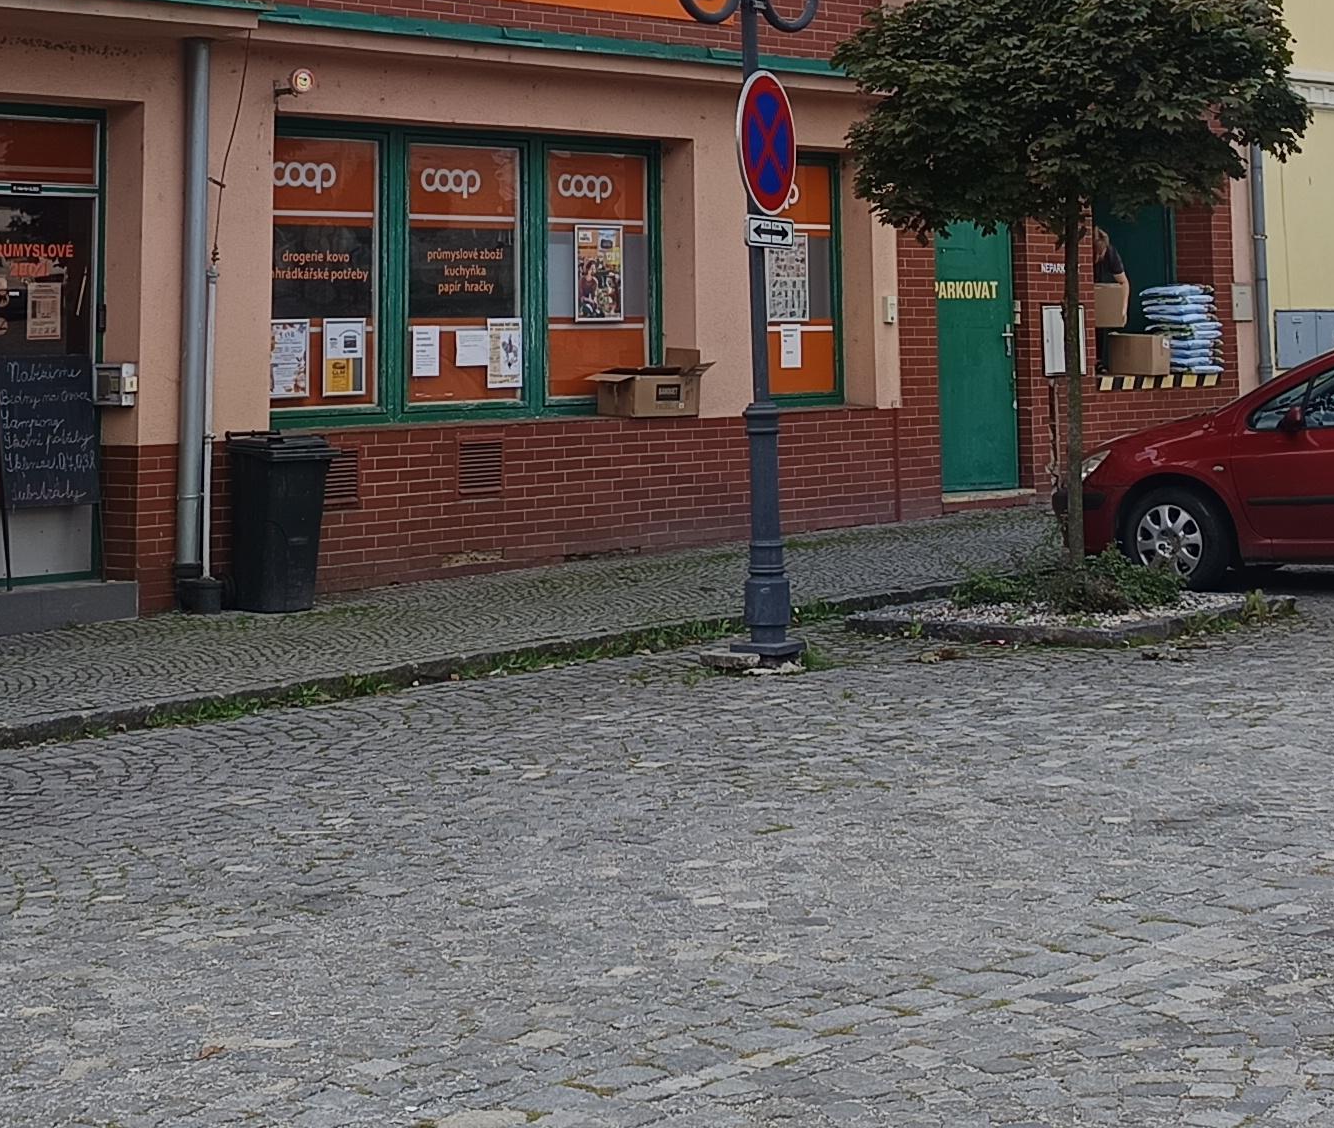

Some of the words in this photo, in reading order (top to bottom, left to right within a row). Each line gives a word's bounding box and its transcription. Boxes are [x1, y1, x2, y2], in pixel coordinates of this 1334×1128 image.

[273, 162, 337, 194] coop
[420, 167, 481, 199] coop
[557, 173, 613, 204] coop
[282, 250, 324, 265] drogerie
[327, 250, 350, 263] kovo
[427, 248, 479, 263] průmyslové
[480, 248, 504, 260] zboží
[331, 268, 368, 283] potřeby
[444, 265, 487, 279] kuchyňka
[1040, 263, 1080, 274] NEPARK
[438, 280, 462, 295] papír
[464, 280, 495, 295] hračky
